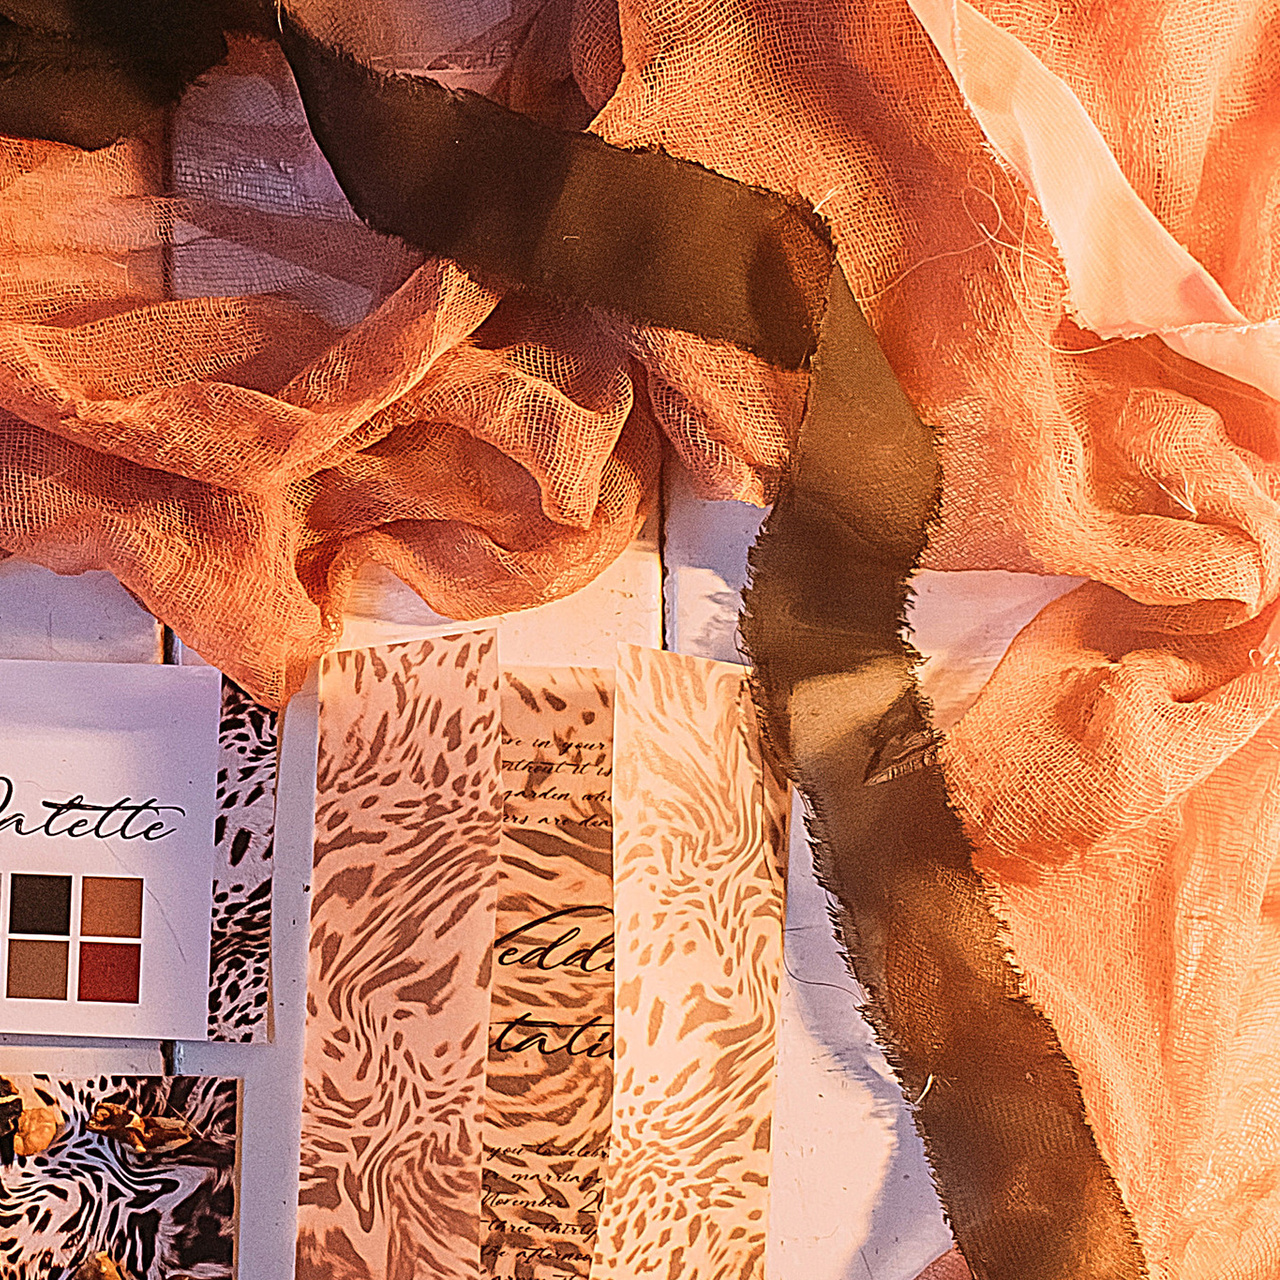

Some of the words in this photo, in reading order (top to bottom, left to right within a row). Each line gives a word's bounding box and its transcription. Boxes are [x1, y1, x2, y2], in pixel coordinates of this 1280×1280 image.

[532, 738, 553, 749] in
[558, 741, 607, 756] your
[487, 1146, 526, 1161] you
[481, 1184, 563, 1207] November
